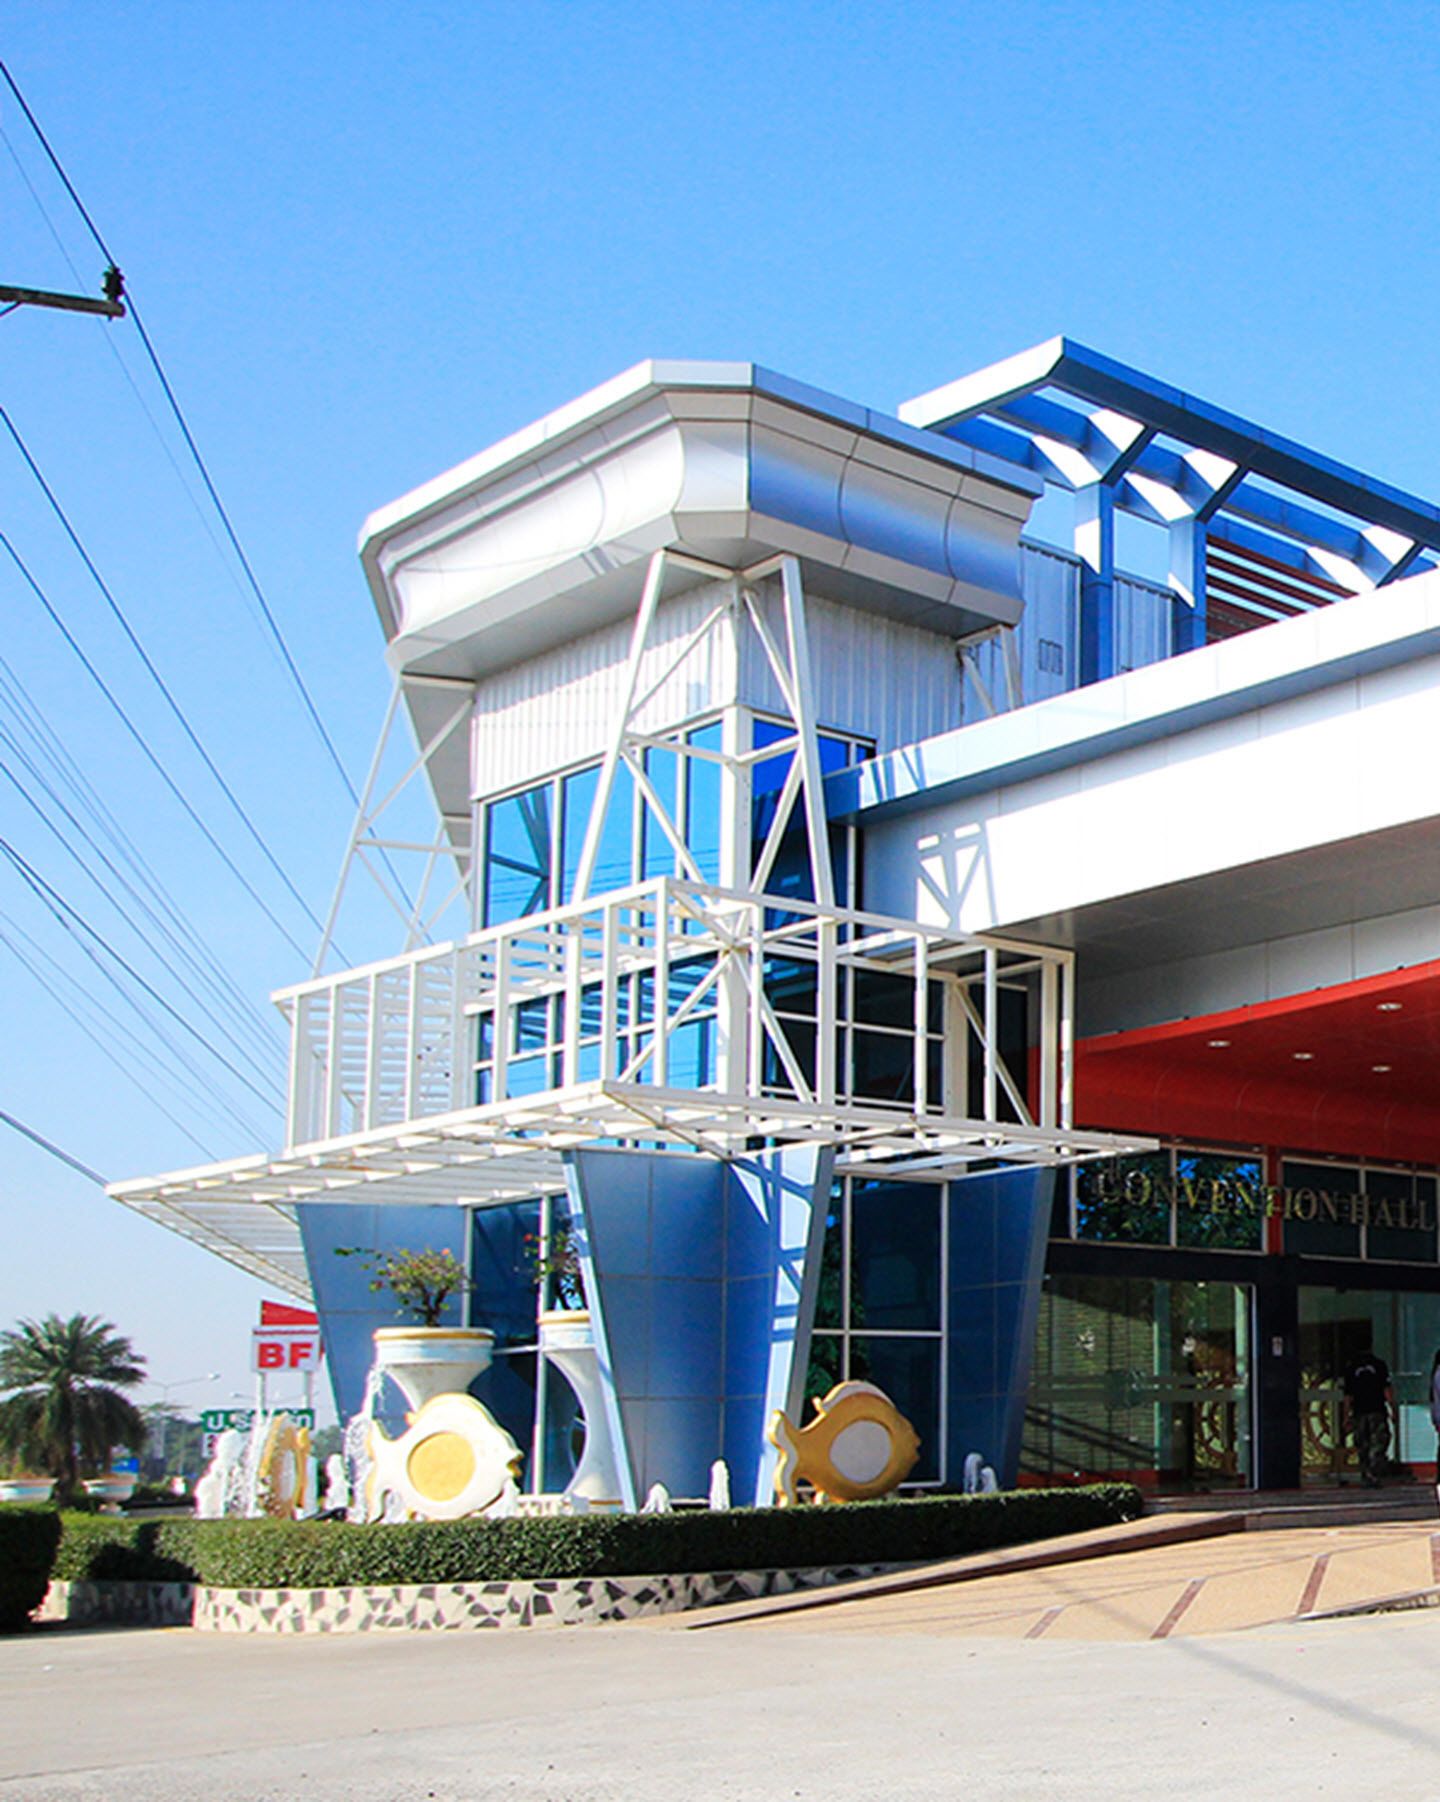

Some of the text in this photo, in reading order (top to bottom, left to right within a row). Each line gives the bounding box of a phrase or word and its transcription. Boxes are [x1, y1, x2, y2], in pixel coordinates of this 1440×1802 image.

[1095, 1169, 1437, 1232] CONVENTION HALL
[257, 1342, 313, 1369] BF
